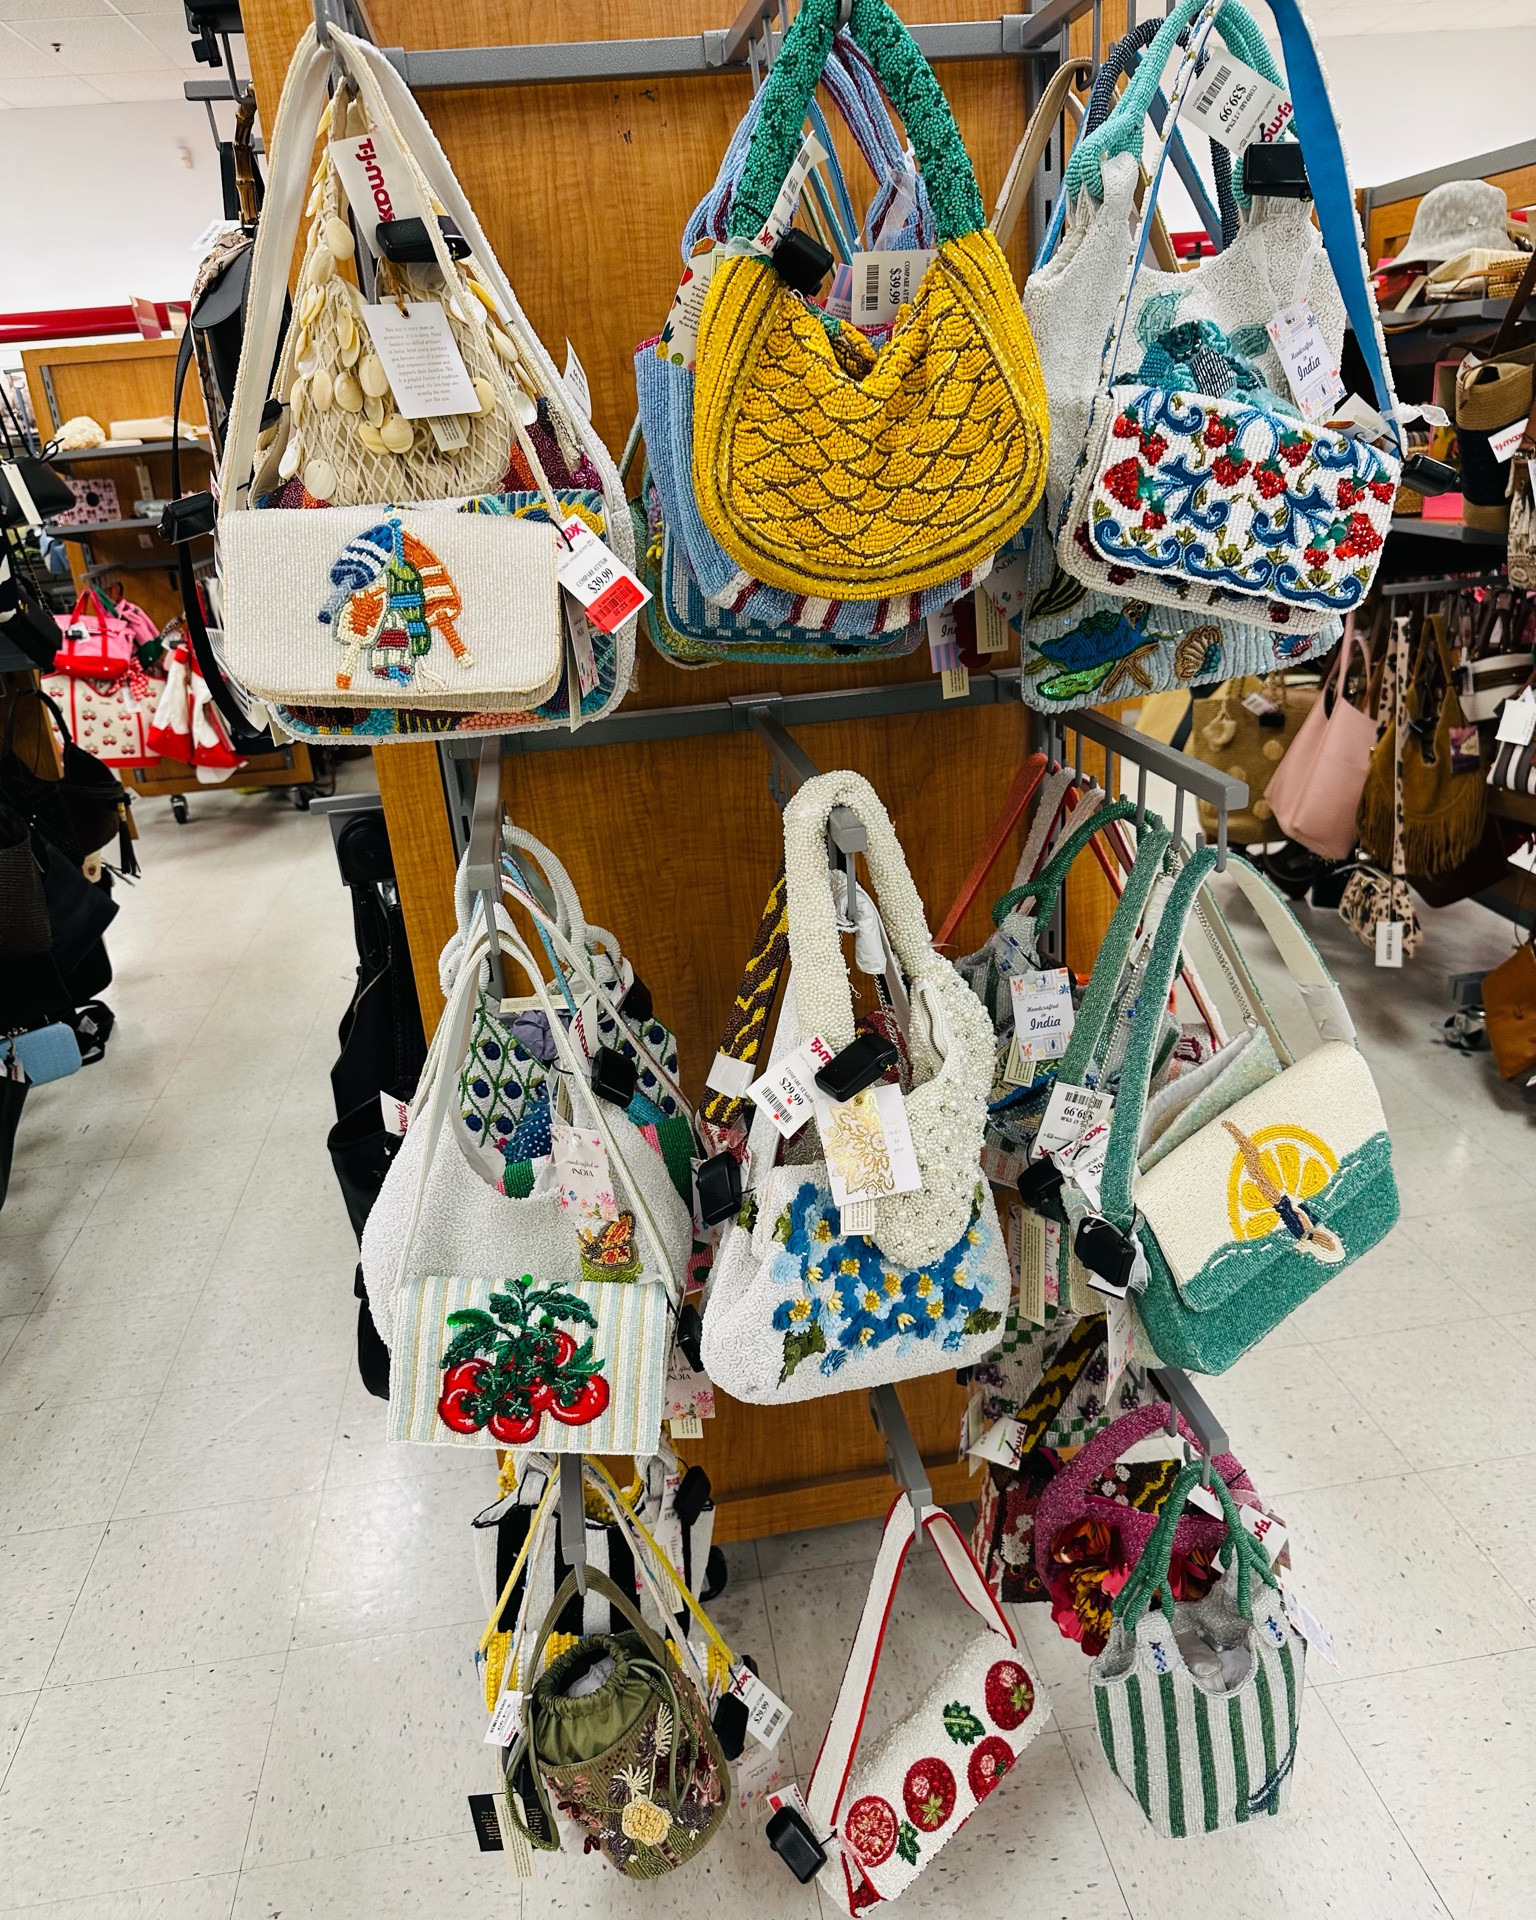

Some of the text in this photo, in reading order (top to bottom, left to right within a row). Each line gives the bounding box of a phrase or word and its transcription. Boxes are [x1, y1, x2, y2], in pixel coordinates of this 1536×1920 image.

[1219, 83, 1246, 122] $39.99
[889, 268, 902, 305] $39.99
[1297, 356, 1321, 381] India
[587, 567, 614, 594] $39.99
[1027, 1003, 1059, 1013] Handcrafted
[1030, 1015, 1061, 1031] India
[785, 1066, 801, 1086] COMPARE
[779, 1077, 804, 1106] $29.99
[572, 1168, 594, 1178] INDIA
